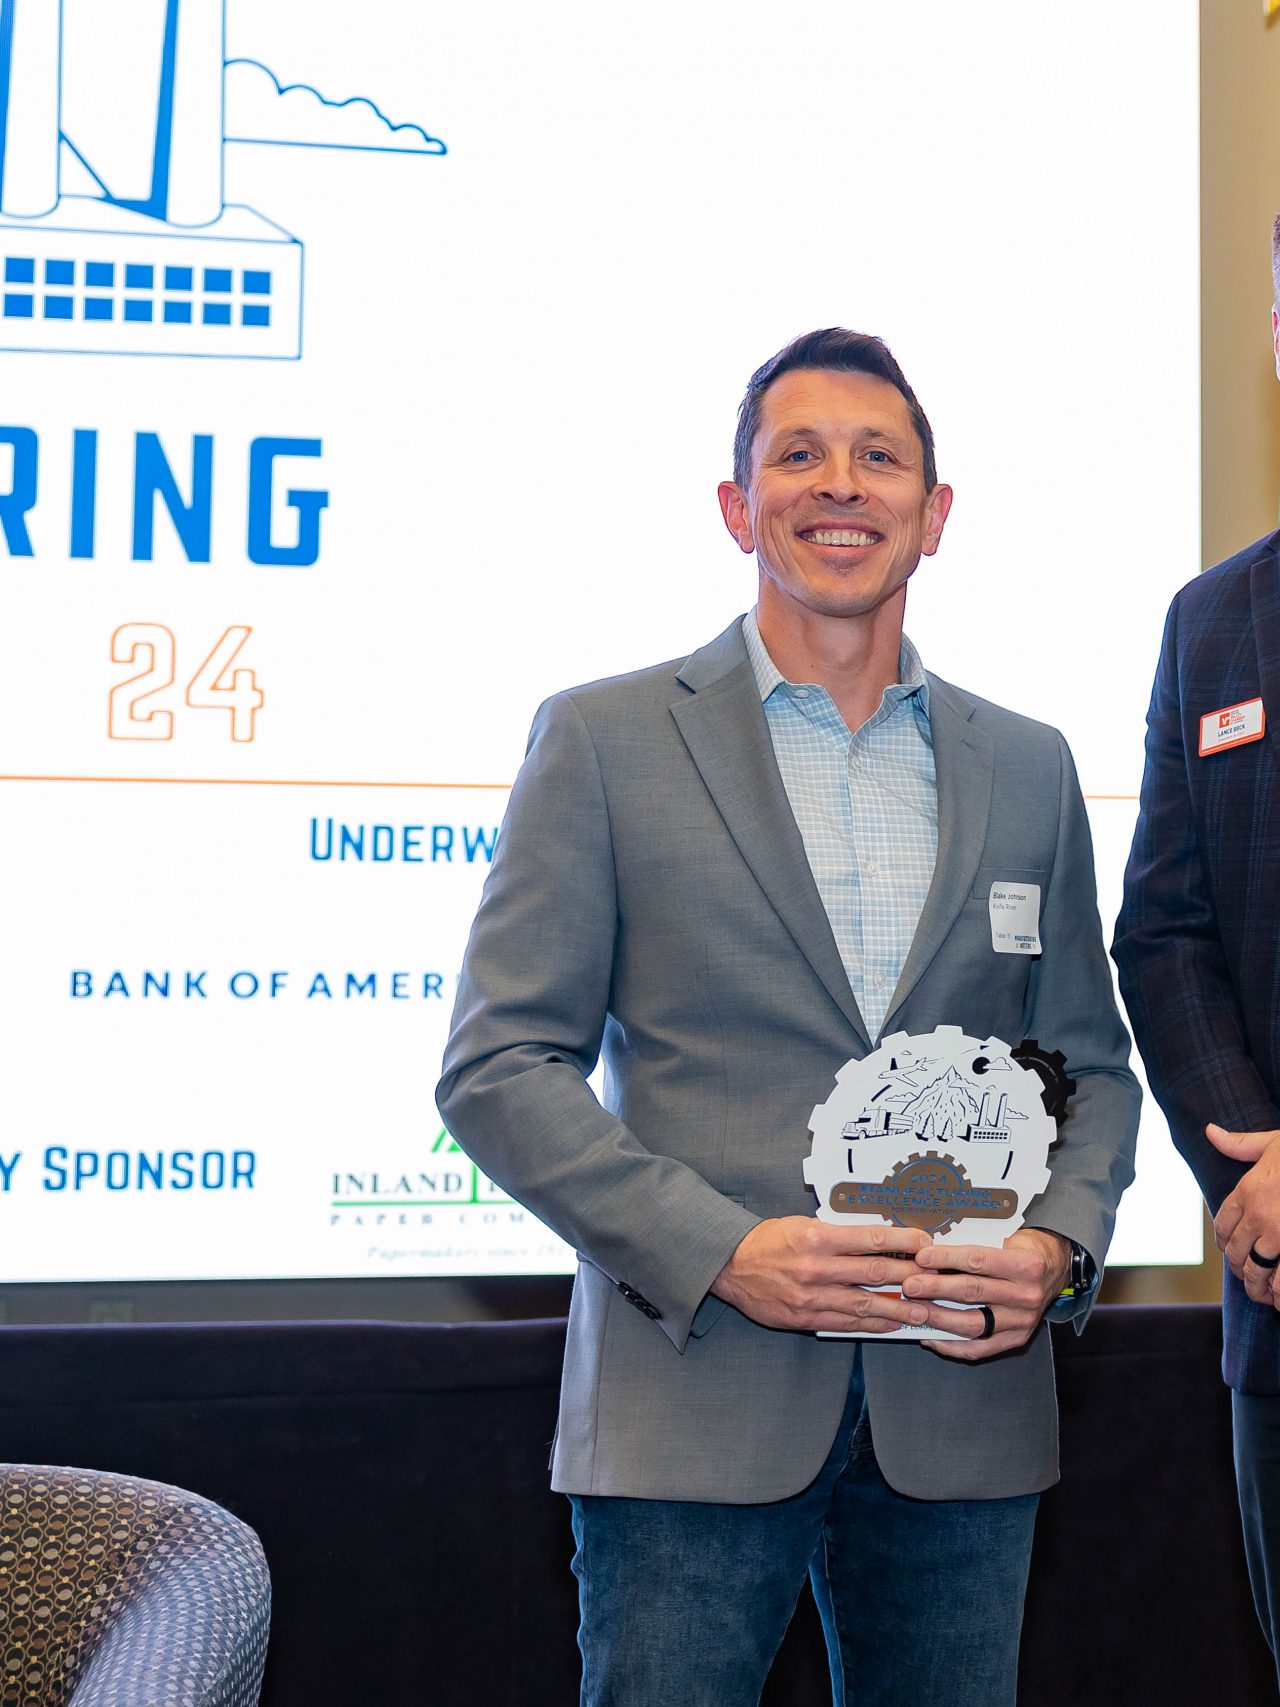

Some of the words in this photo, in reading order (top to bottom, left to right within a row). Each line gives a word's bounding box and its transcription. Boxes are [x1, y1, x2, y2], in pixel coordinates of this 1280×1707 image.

[108, 623, 264, 742] 24
[1218, 728, 1233, 737] LANCE
[1233, 724, 1245, 732] BECK
[310, 817, 499, 863] UNDERW
[69, 970, 207, 999] BANK
[229, 970, 289, 1000] OF
[307, 971, 460, 1000] AMER
[43, 1146, 256, 1192] SPONSOR
[333, 1174, 462, 1194] INLAND
[910, 1174, 947, 1183] 2024
[860, 1184, 991, 1199] MANUFACTURING
[847, 1194, 940, 1207] EXCELLENCE
[945, 1200, 1001, 1209] AWARD
[331, 1213, 433, 1226] PAPER
[459, 1212, 525, 1224] COM
